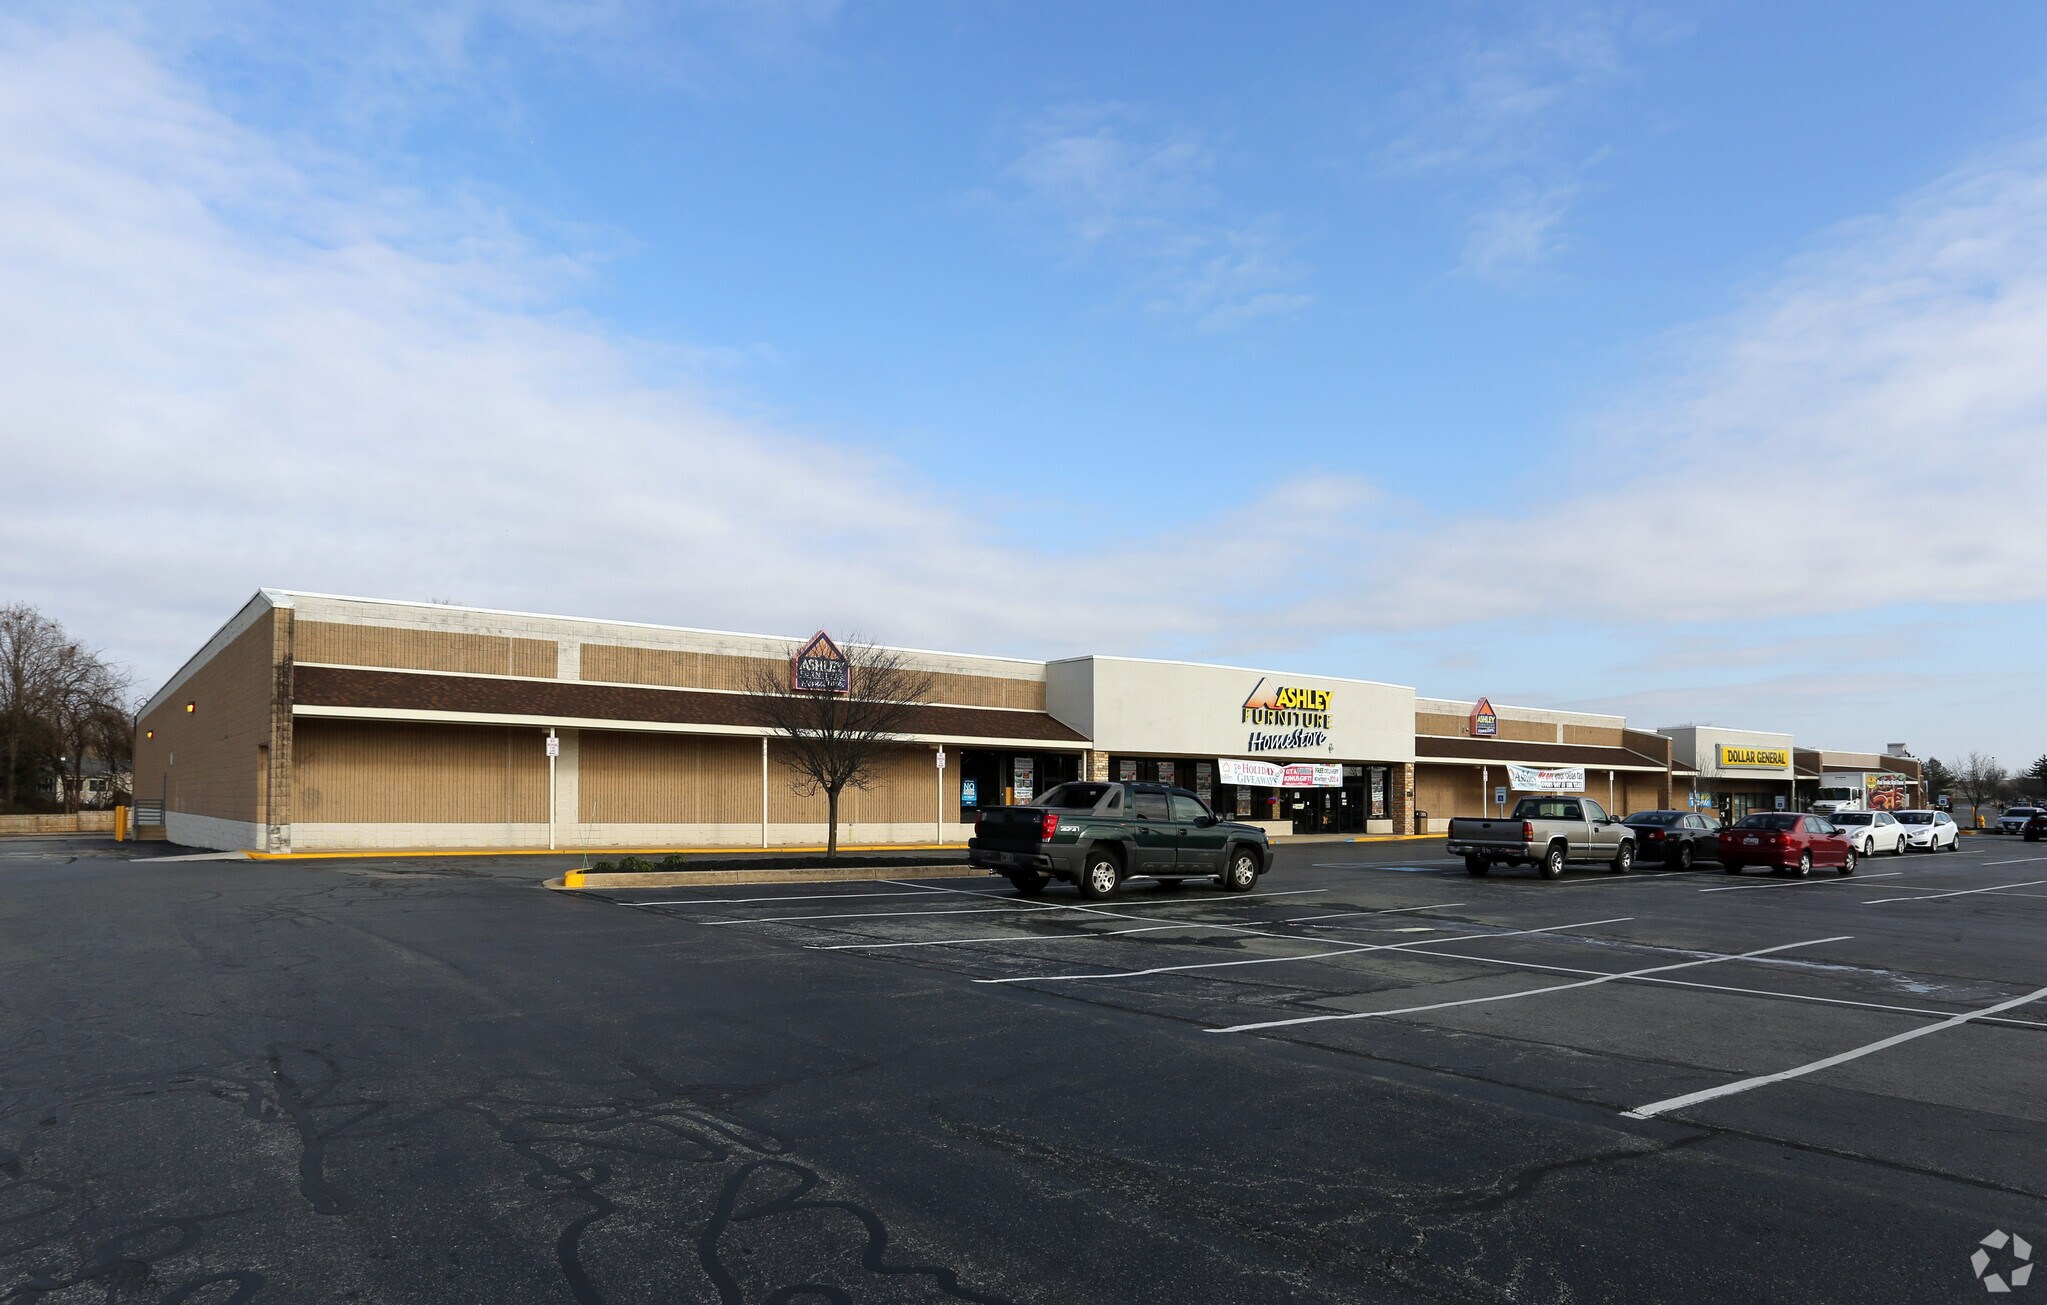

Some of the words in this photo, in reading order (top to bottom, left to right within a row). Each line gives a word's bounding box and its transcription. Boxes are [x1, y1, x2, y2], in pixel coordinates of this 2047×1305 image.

[799, 659, 845, 672] ASHLEY
[1276, 687, 1334, 710] ASHLEY
[1242, 708, 1333, 729] FURNITURE
[1477, 715, 1495, 723] ASHLEY
[1248, 729, 1327, 752] HomeStore
[1727, 750, 1756, 764] DOLLAR
[1757, 750, 1786, 765] GENERAL
[963, 782, 975, 790] NO
